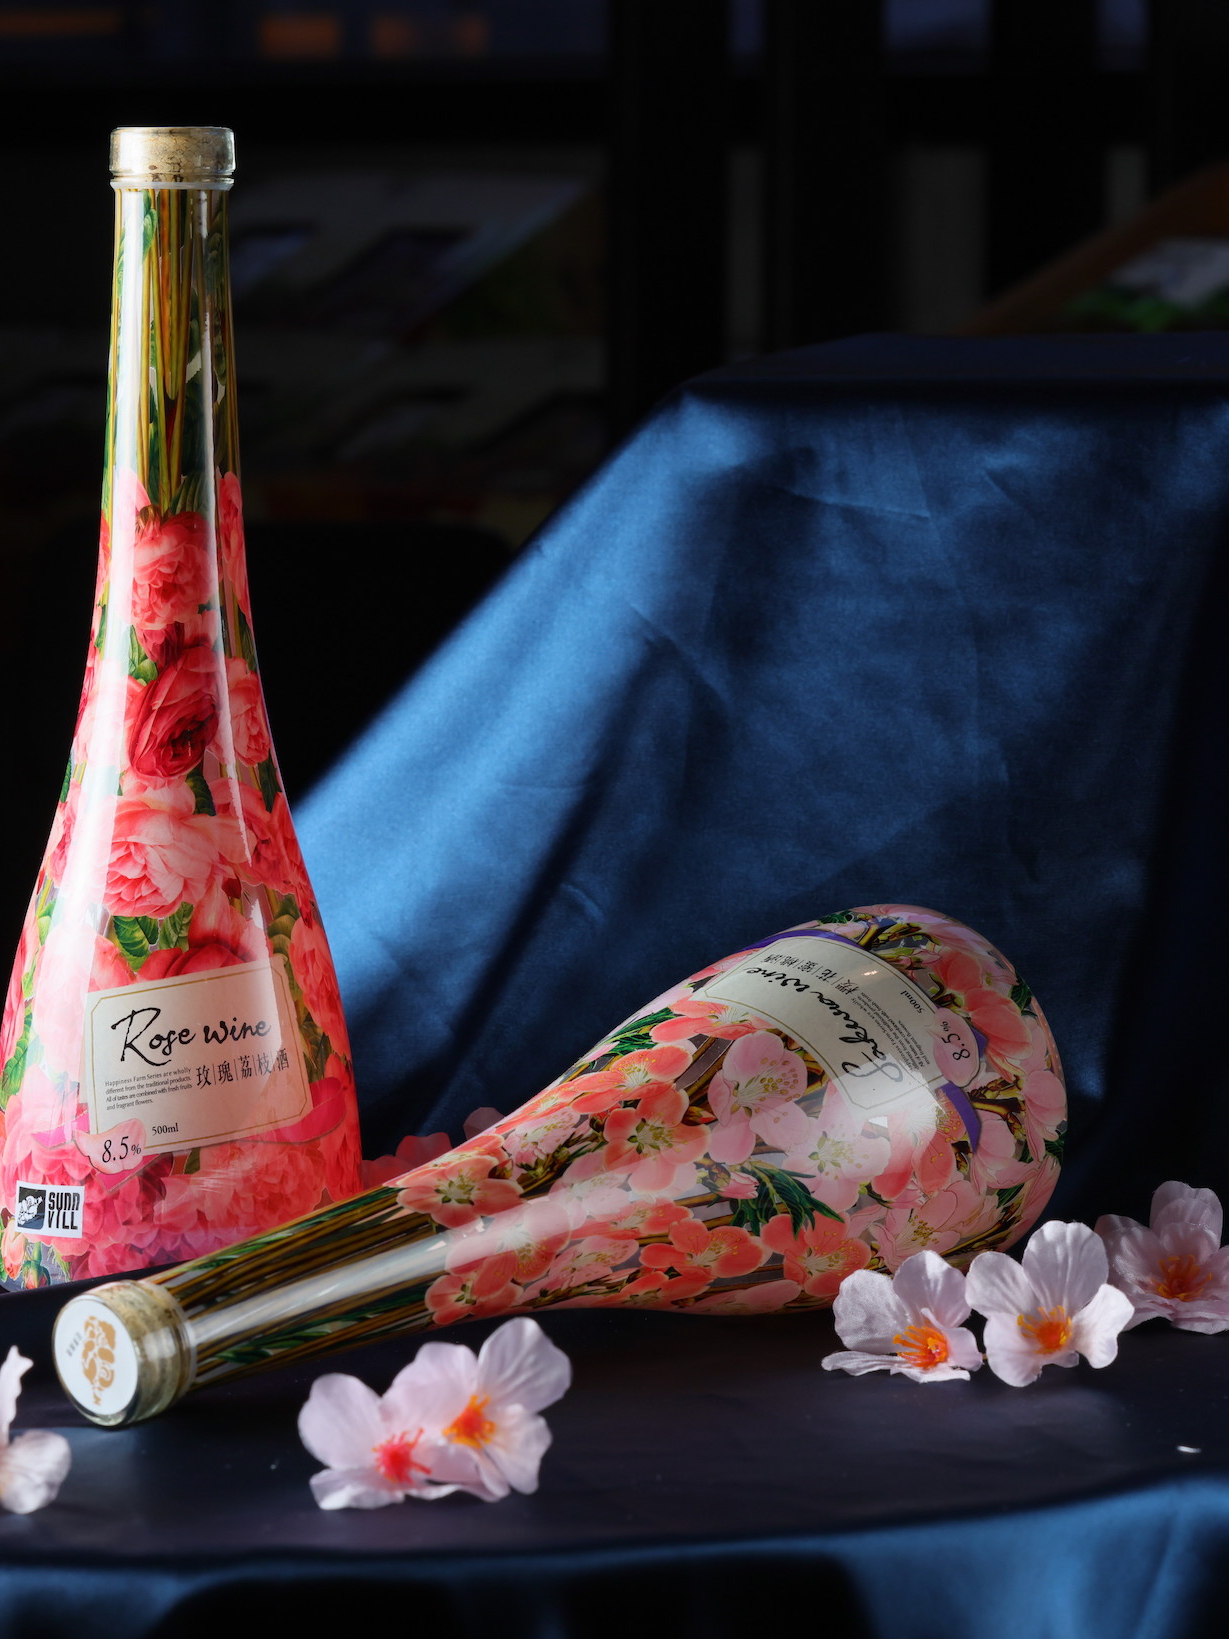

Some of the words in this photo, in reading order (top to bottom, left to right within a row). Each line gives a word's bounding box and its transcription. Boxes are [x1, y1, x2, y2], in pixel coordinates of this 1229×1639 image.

[744, 967, 810, 992] wine
[900, 990, 926, 1014] 500ml
[111, 1008, 196, 1066] Rose
[204, 1017, 271, 1044] wine
[811, 991, 903, 1082] Sakura
[941, 1021, 970, 1060] 8.5%
[105, 1077, 132, 1087] Happiness
[136, 1090, 157, 1098] combined
[146, 1080, 169, 1088] traditional
[116, 1100, 134, 1109] fragrant
[152, 1123, 179, 1136] 500ml
[102, 1136, 141, 1163] 8.5%
